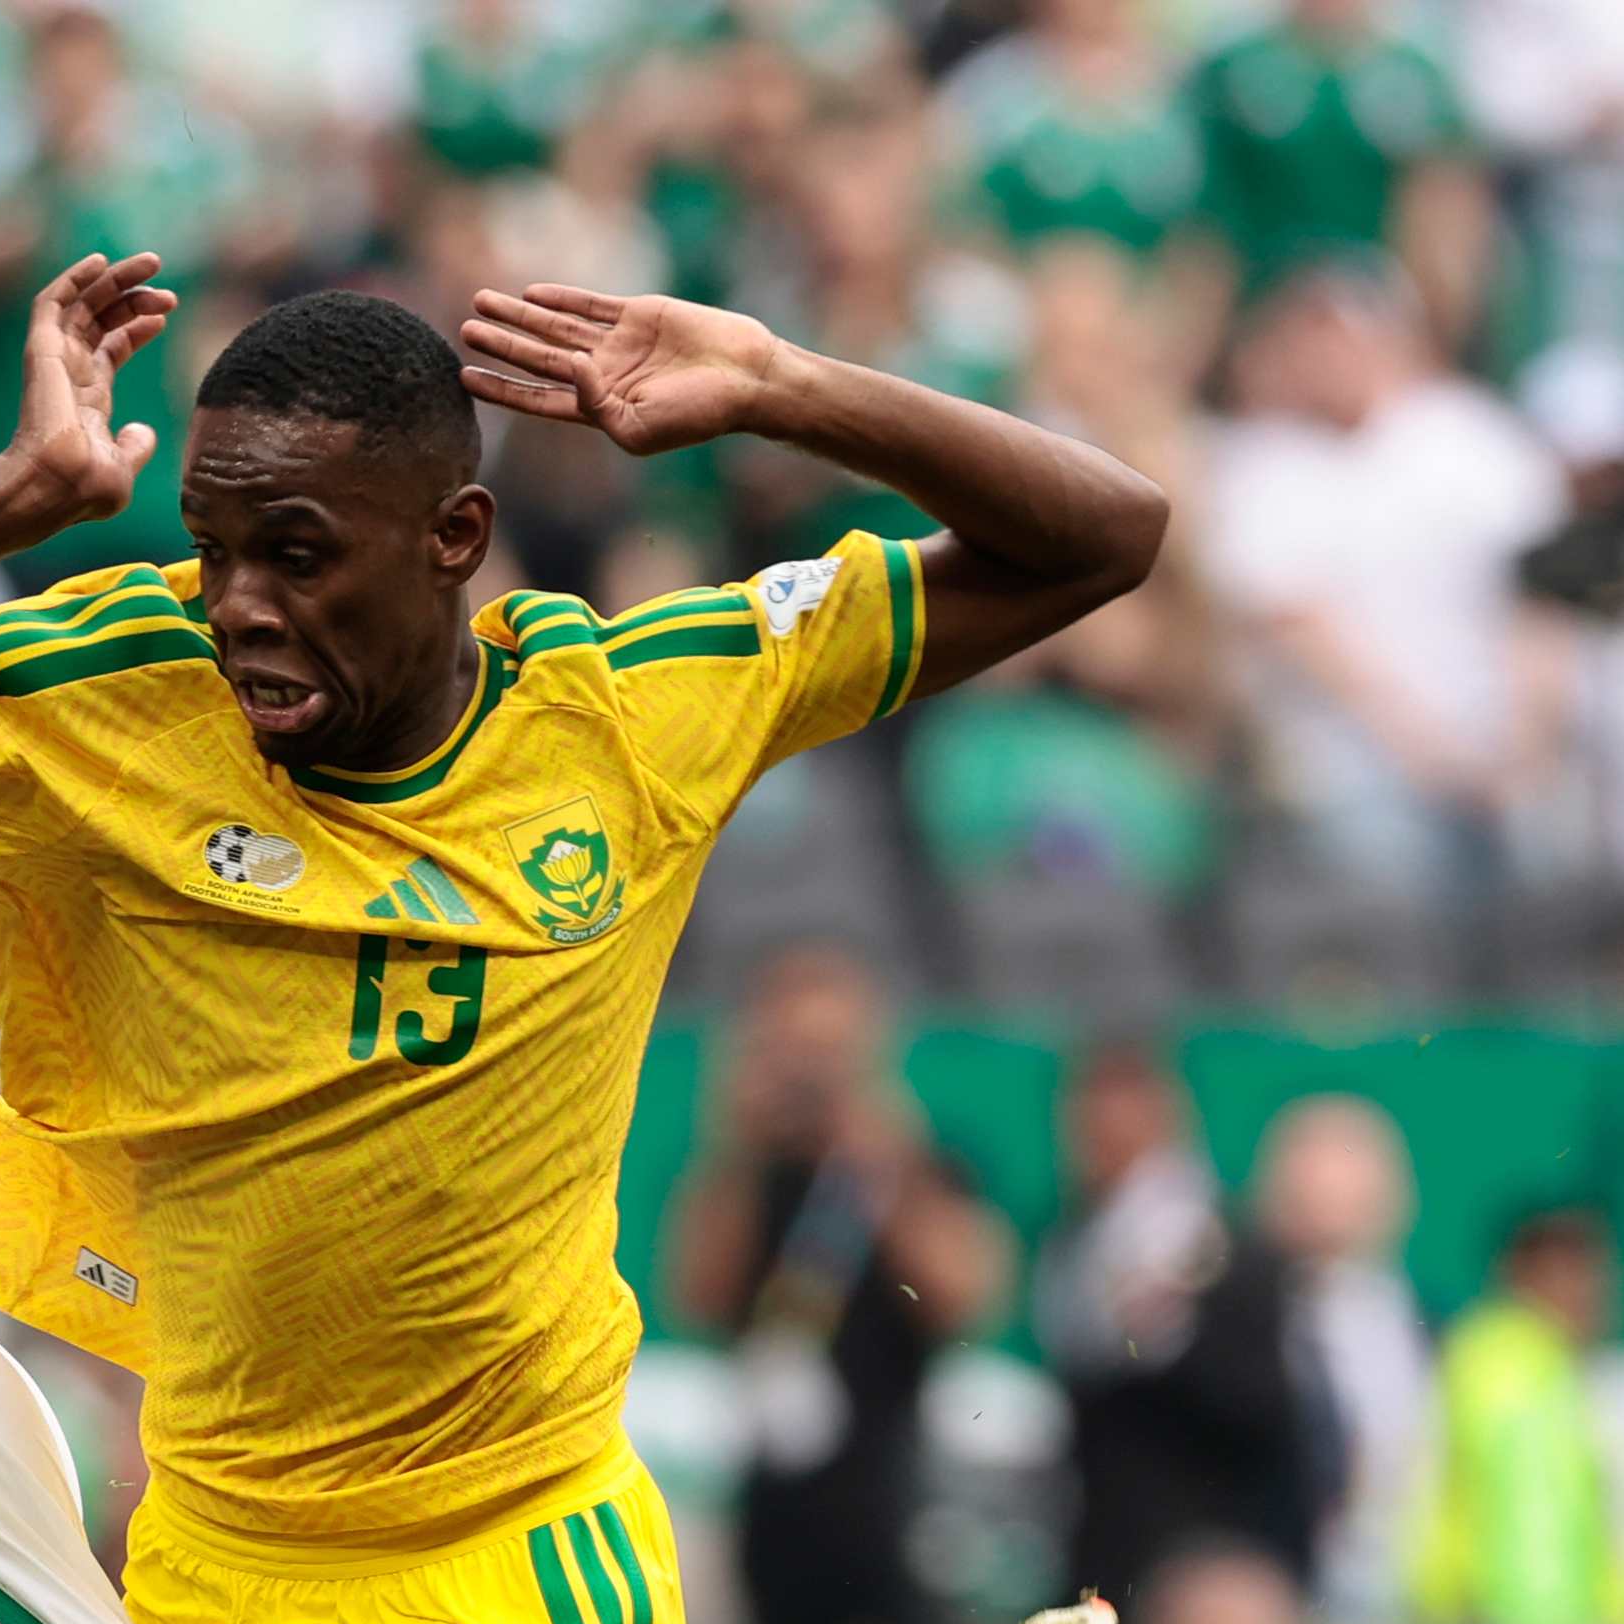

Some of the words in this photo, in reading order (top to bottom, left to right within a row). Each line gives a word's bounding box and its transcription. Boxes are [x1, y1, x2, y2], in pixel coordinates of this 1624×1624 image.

[184, 884, 233, 902] FOOTBALL
[236, 898, 301, 914] ASSOCIATION
[207, 880, 239, 895] SOUTH
[242, 889, 283, 903] AFRICAN
[554, 928, 589, 941] SOUTH
[348, 933, 488, 1066] 13
